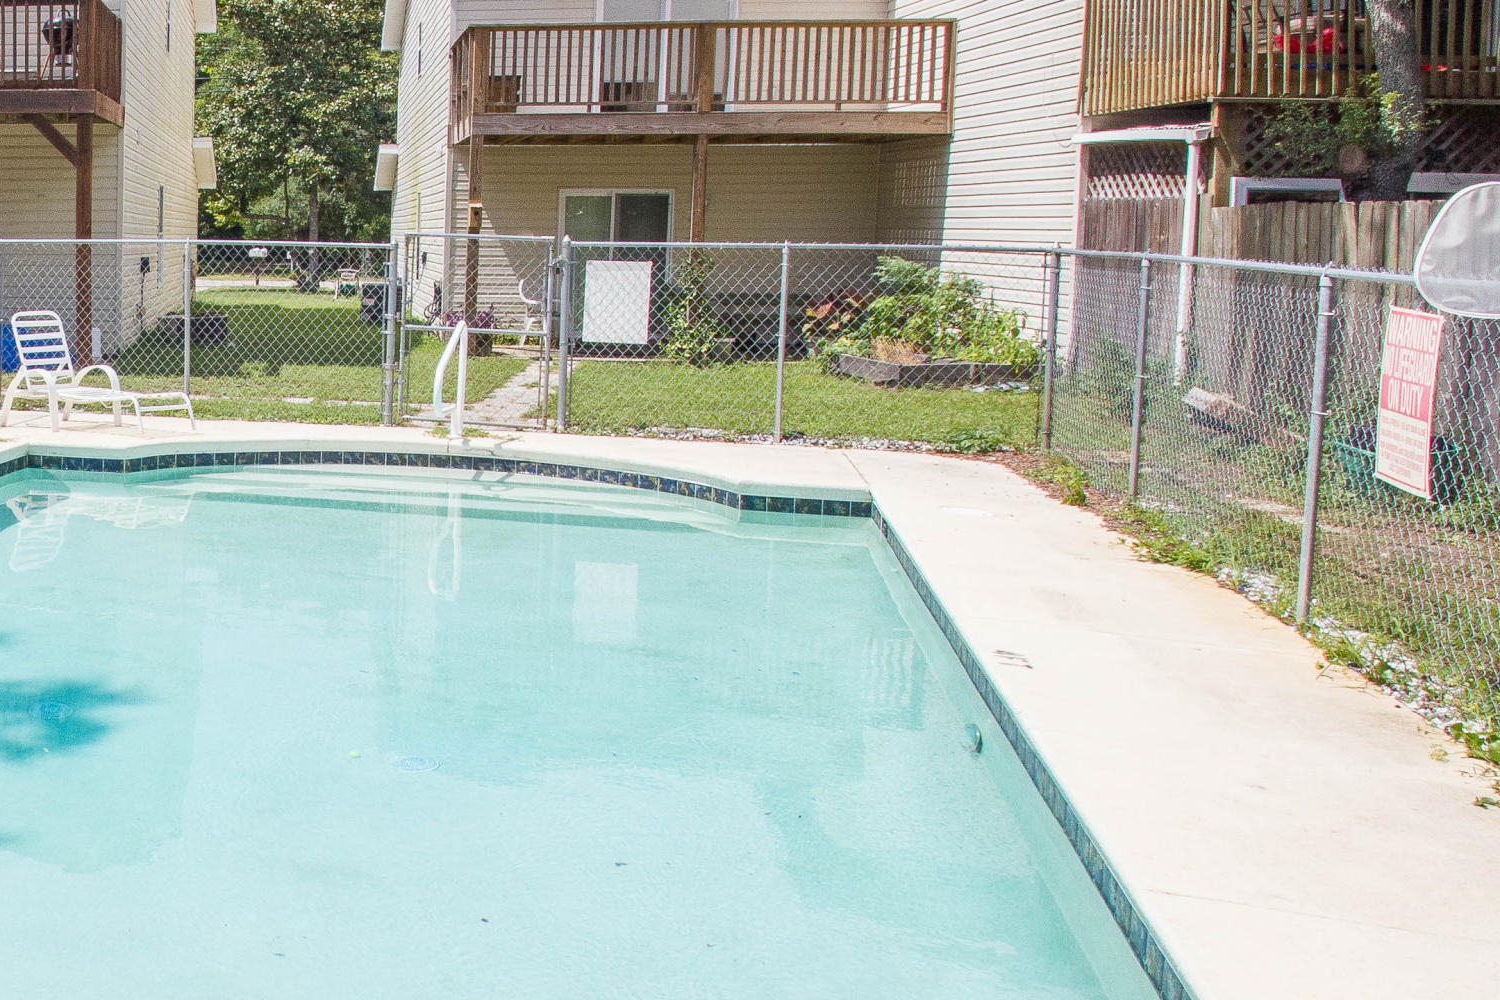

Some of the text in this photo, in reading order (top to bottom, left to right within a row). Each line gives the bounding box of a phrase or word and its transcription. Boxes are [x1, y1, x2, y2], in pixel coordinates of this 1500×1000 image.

[1388, 313, 1438, 353] WARNING
[1393, 347, 1435, 386] LIFEGUARD
[1387, 378, 1424, 417] ON DUTY
